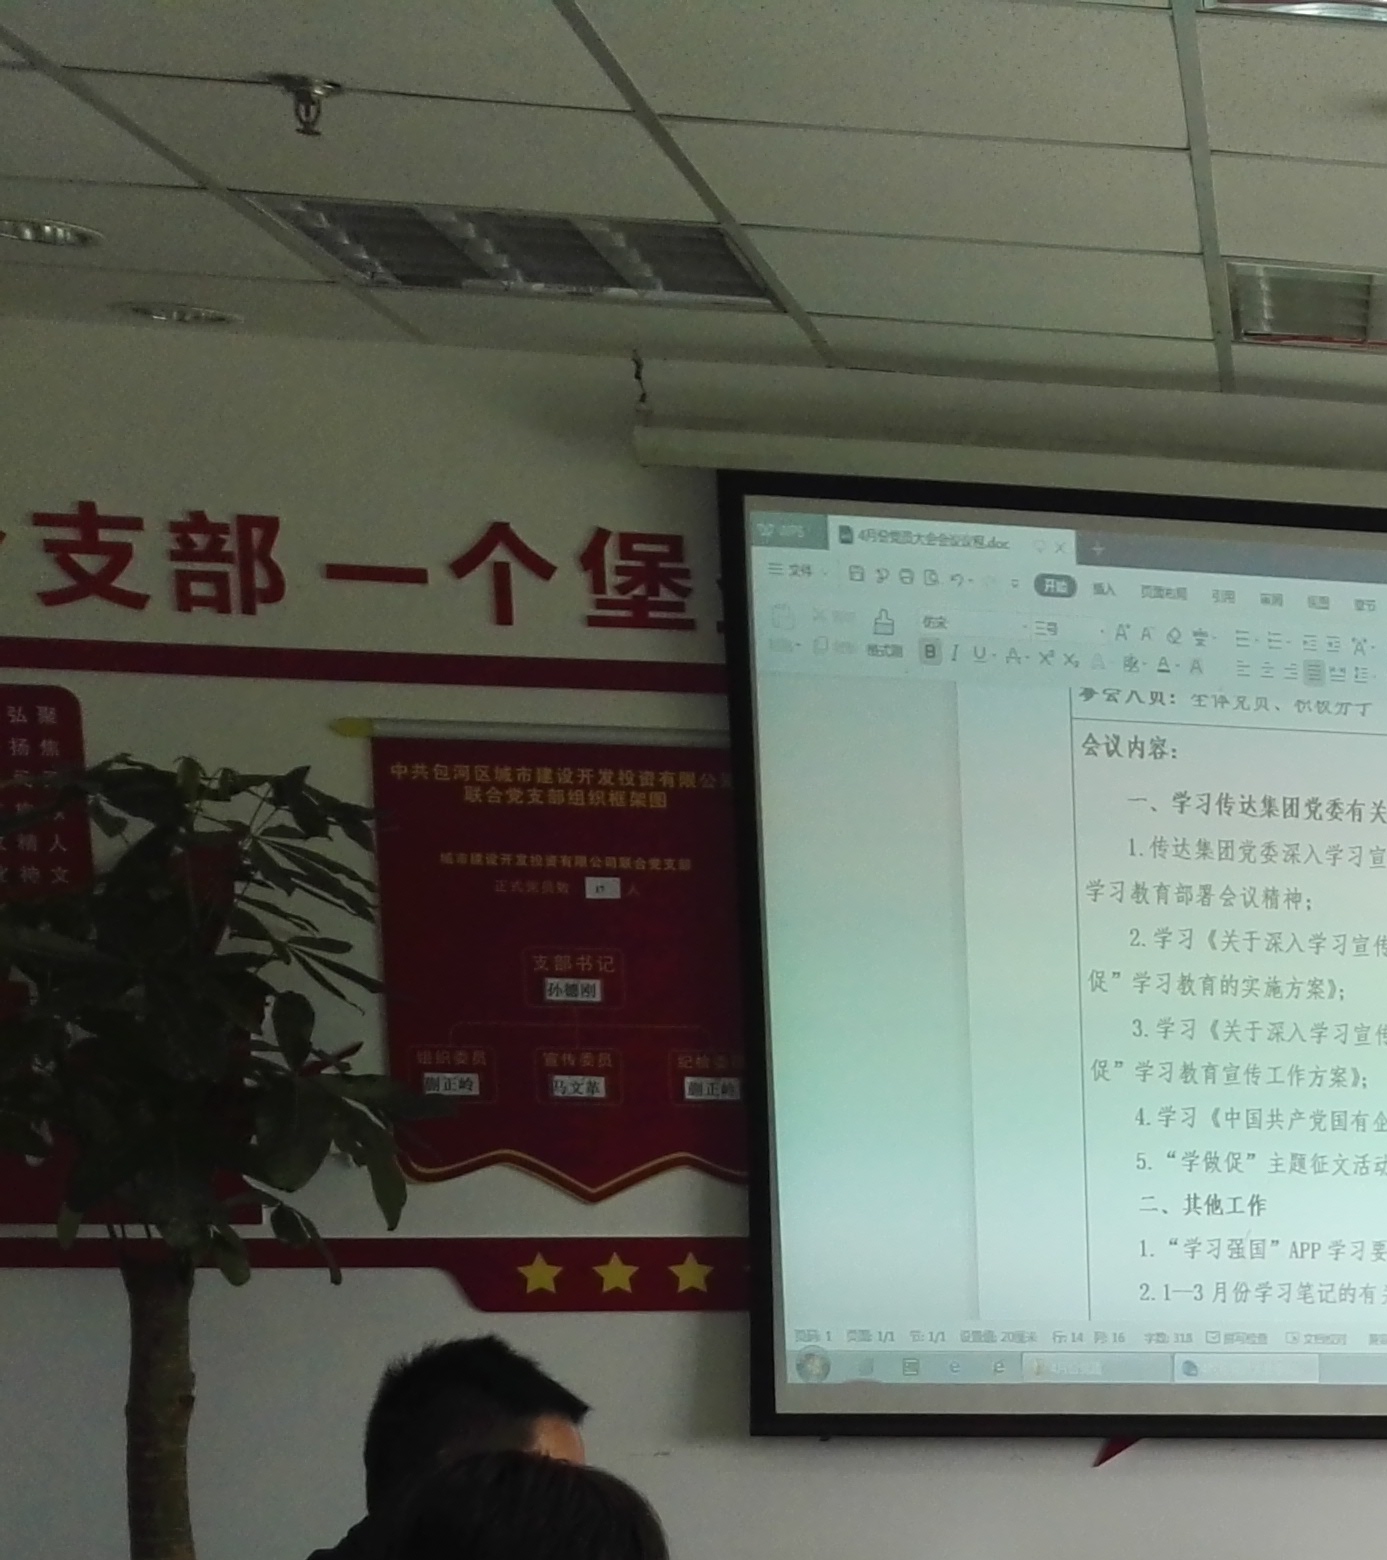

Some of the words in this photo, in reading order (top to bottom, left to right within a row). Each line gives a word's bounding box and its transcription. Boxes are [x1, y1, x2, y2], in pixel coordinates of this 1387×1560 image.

[0, 500, 728, 633] 支部一个堡
[1043, 577, 1068, 594] 开始
[1080, 731, 1179, 761] 会议内容：
[464, 785, 668, 808] 联合党支部组织框架图
[1084, 879, 1315, 914] 学习教育部署会议精神；
[532, 953, 617, 974] 支部书记
[542, 1051, 614, 1069] 宣传委员
[1138, 1191, 1268, 1218] 二、其他工作
[1070, 1332, 1084, 1343] 14
[1111, 1331, 1126, 1344] 16
